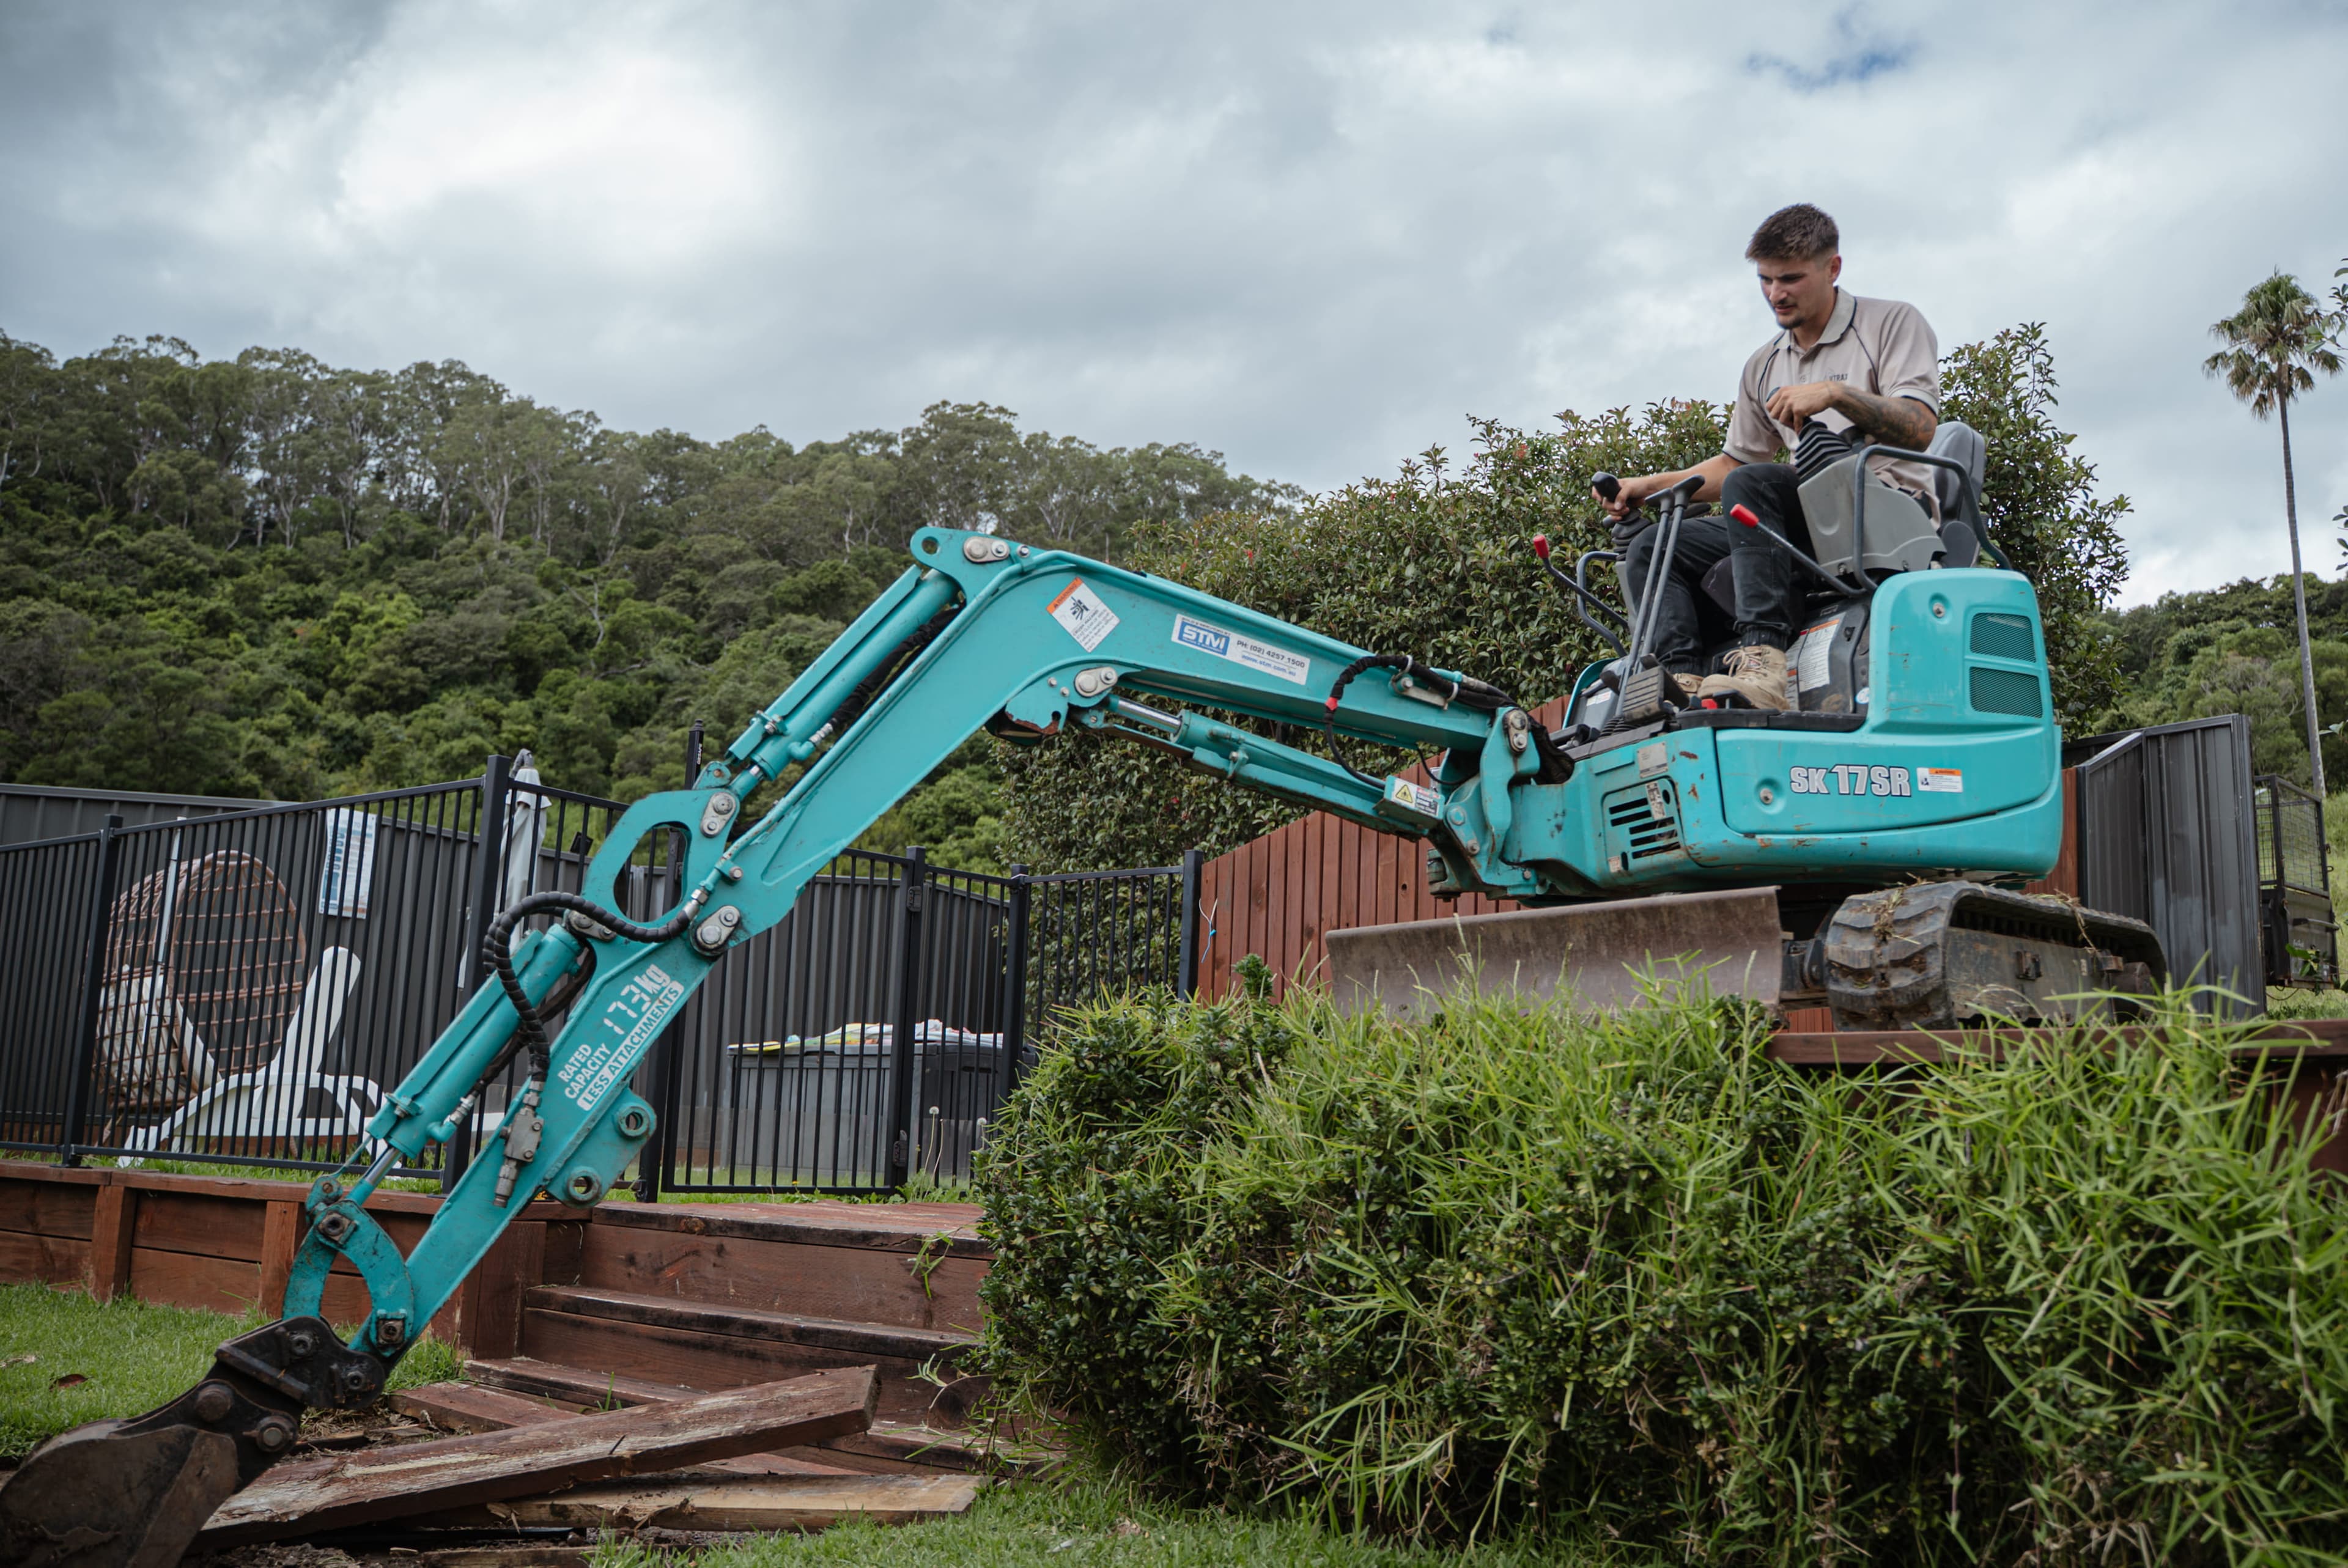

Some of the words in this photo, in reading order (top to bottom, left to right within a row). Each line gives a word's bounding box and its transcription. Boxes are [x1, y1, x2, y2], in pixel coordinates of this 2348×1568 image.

[1183, 625, 1225, 649] STM
[1242, 655, 1296, 676] www.stm.com.au
[1250, 645, 1264, 655] (02)
[1266, 650, 1285, 660] 4257
[1287, 657, 1305, 668] 1500
[1790, 764, 1911, 797] SK17SR
[604, 964, 671, 1035] 173kg
[558, 1044, 592, 1082] RATED
[583, 1075, 610, 1105] LESS
[608, 988, 679, 1075] ATTACHMENTS
[564, 1043, 611, 1099] CAPACITY
